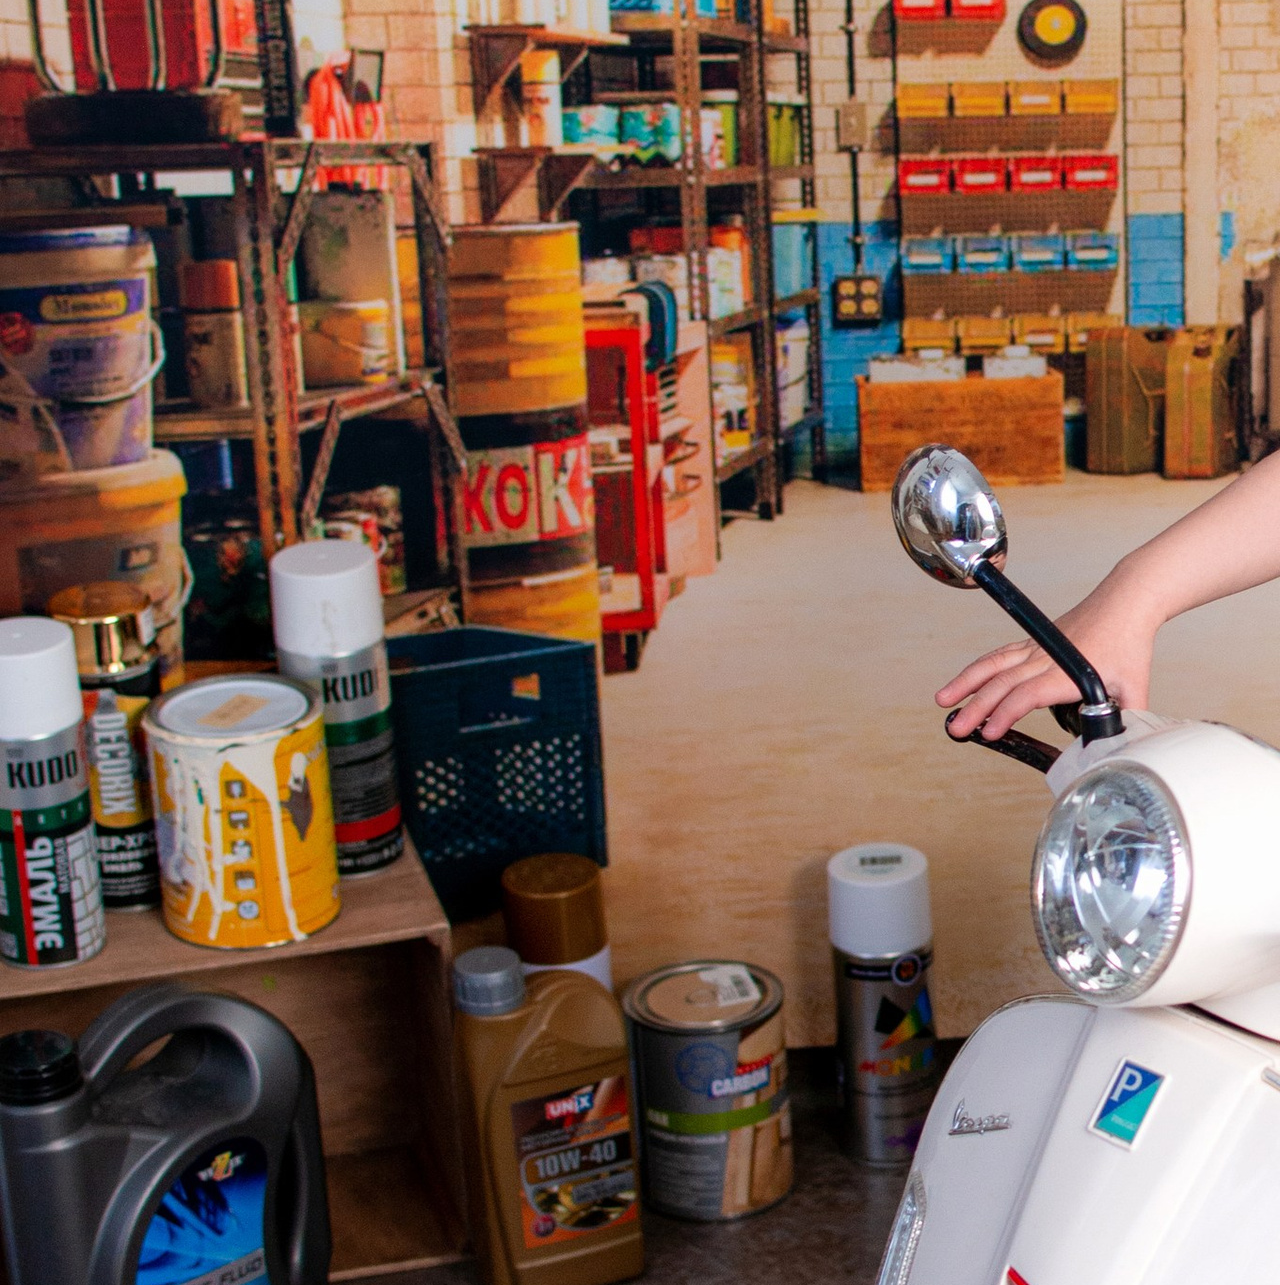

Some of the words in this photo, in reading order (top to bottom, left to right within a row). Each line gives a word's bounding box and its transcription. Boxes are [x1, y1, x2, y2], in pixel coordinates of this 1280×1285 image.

[321, 669, 379, 704] KUD
[7, 748, 79, 789] KUDO
[92, 711, 137, 816] DECORIX
[25, 835, 65, 950] ЭМАЛЬ
[1110, 1066, 1144, 1103] P
[949, 1097, 1012, 1136] Vespa
[533, 1137, 618, 1180] 10W-40
